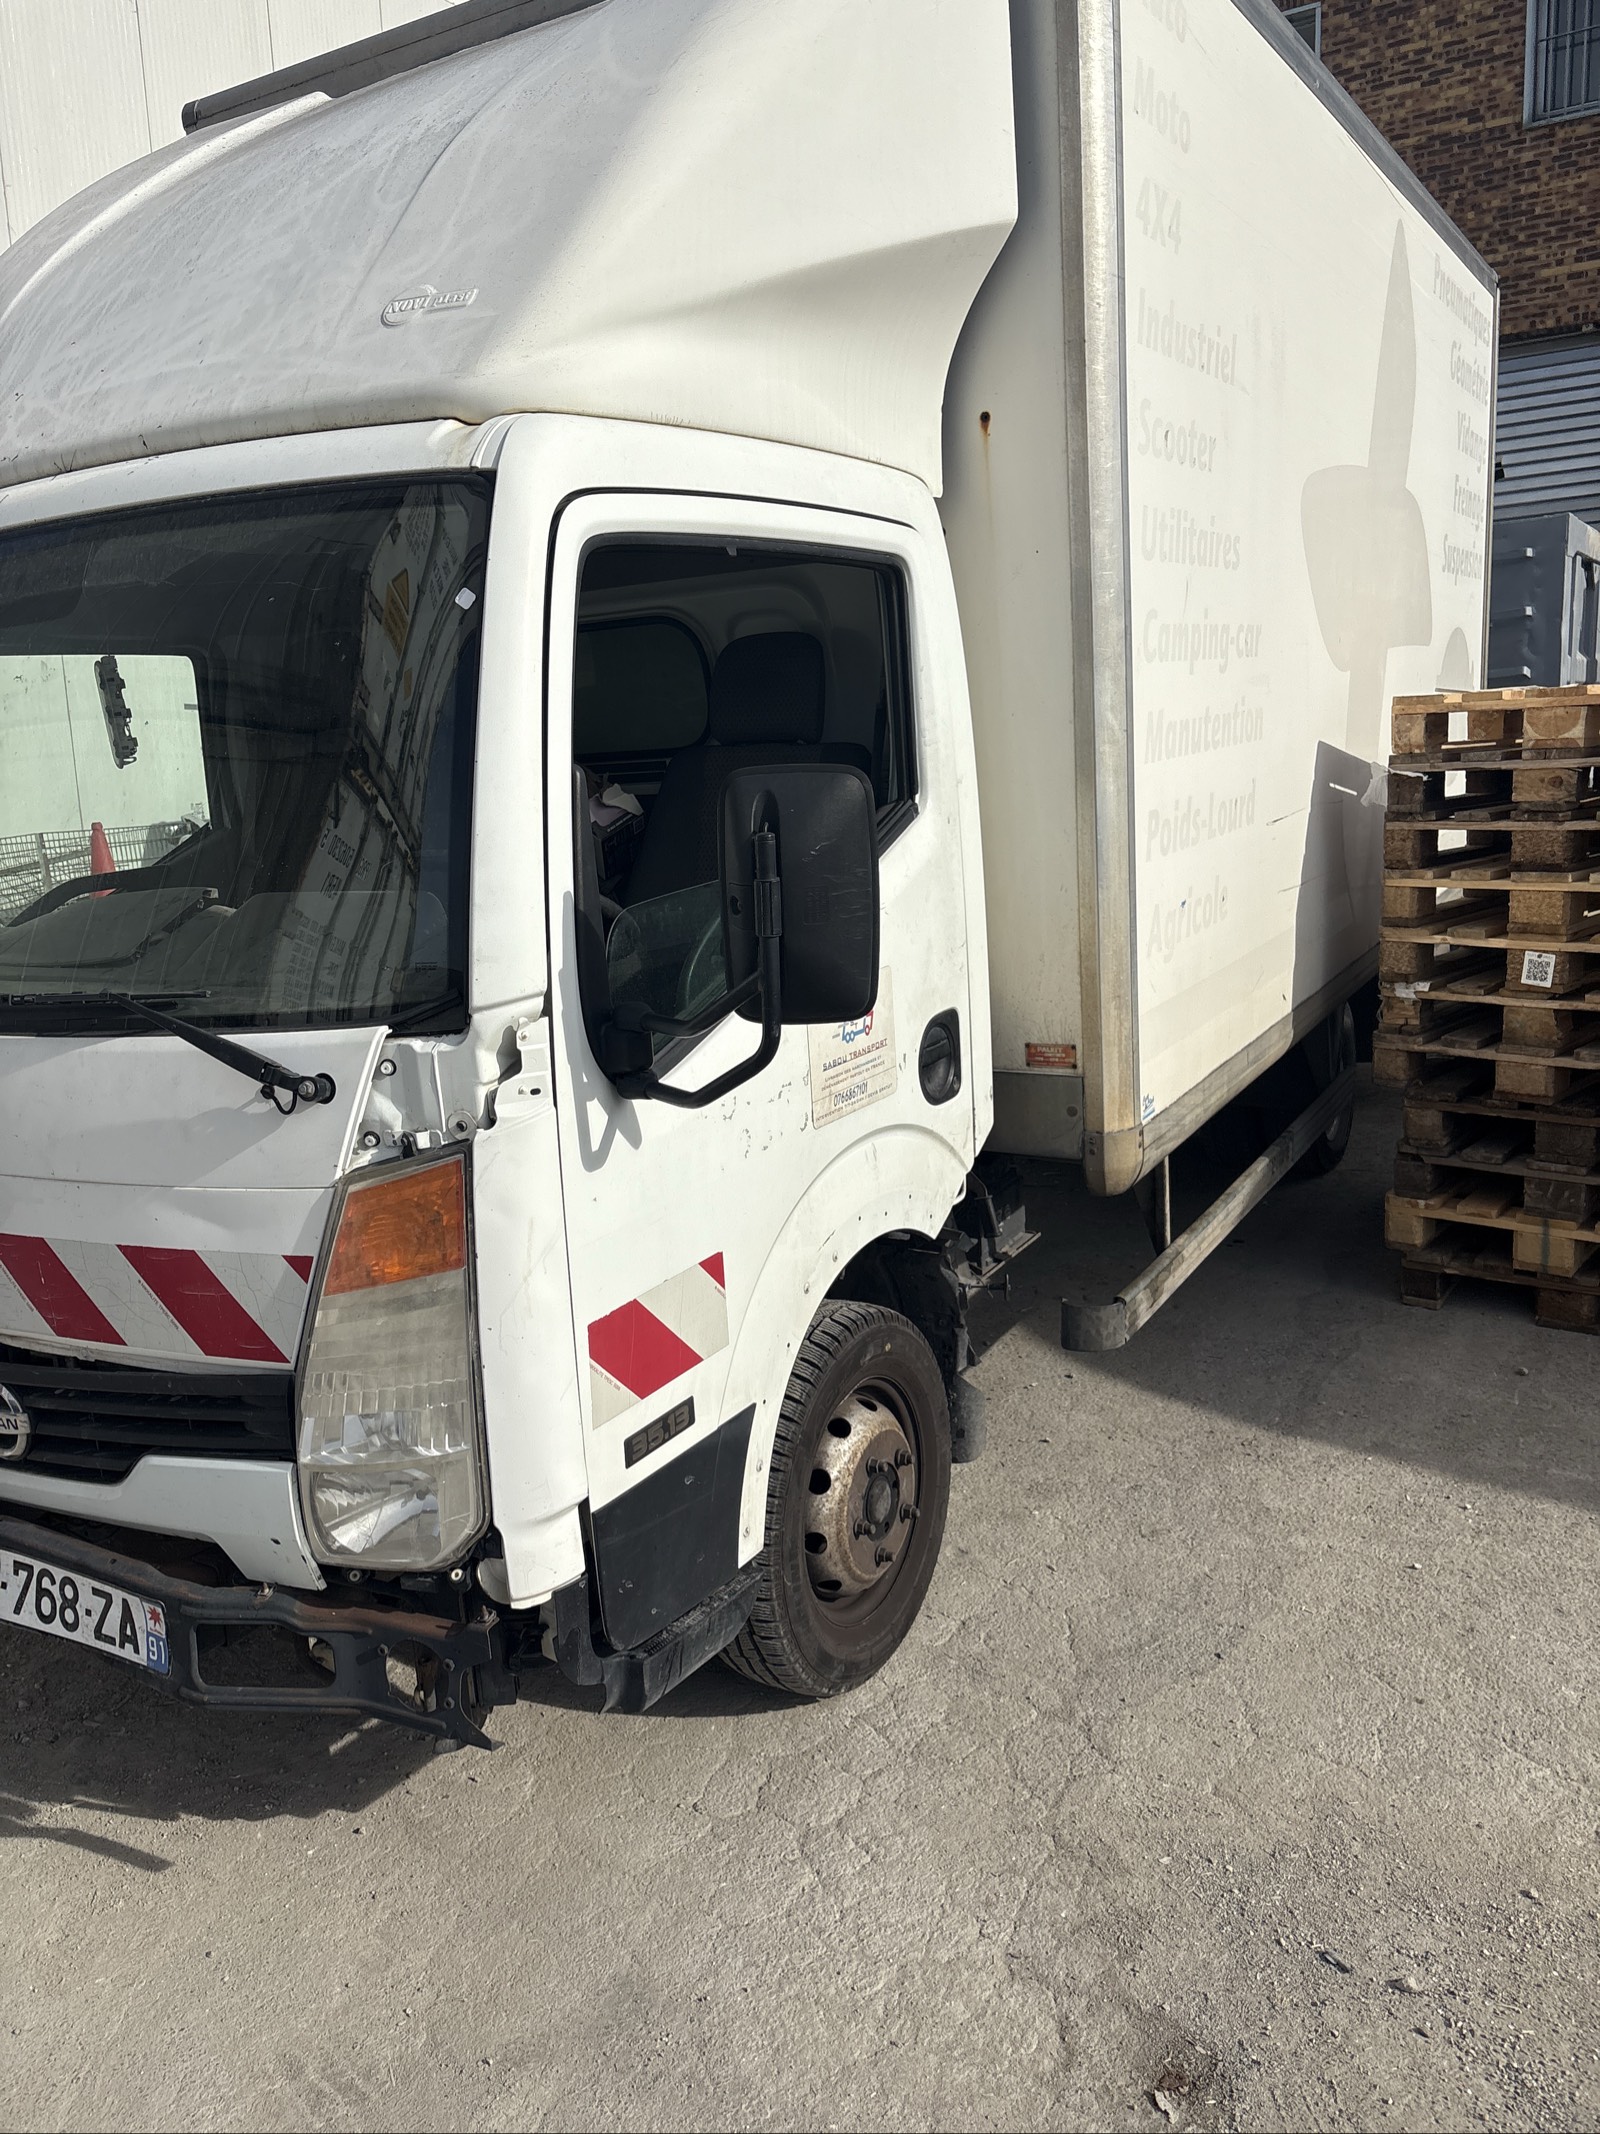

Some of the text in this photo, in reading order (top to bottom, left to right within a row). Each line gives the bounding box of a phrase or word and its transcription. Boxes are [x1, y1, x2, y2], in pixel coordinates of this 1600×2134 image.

[1141, 0, 1187, 43] uto
[1133, 56, 1191, 154] Moto
[1135, 177, 1181, 255] 4X4
[1137, 287, 1238, 386] Industriel
[1137, 398, 1216, 473] Scooter
[1456, 410, 1487, 474] Vidange
[1141, 504, 1240, 570] Utilitaires
[1142, 607, 1263, 675] Camping-car
[1143, 695, 1264, 764] Manutention
[1145, 777, 1257, 862] Poids-Lourd
[1145, 874, 1229, 963] Agricole
[822, 1038, 888, 1072] SABOU TRANSPORT
[833, 1080, 868, 1107] 0766867101
[631, 1403, 690, 1461] 35.13
[149, 1636, 168, 1665] 91
